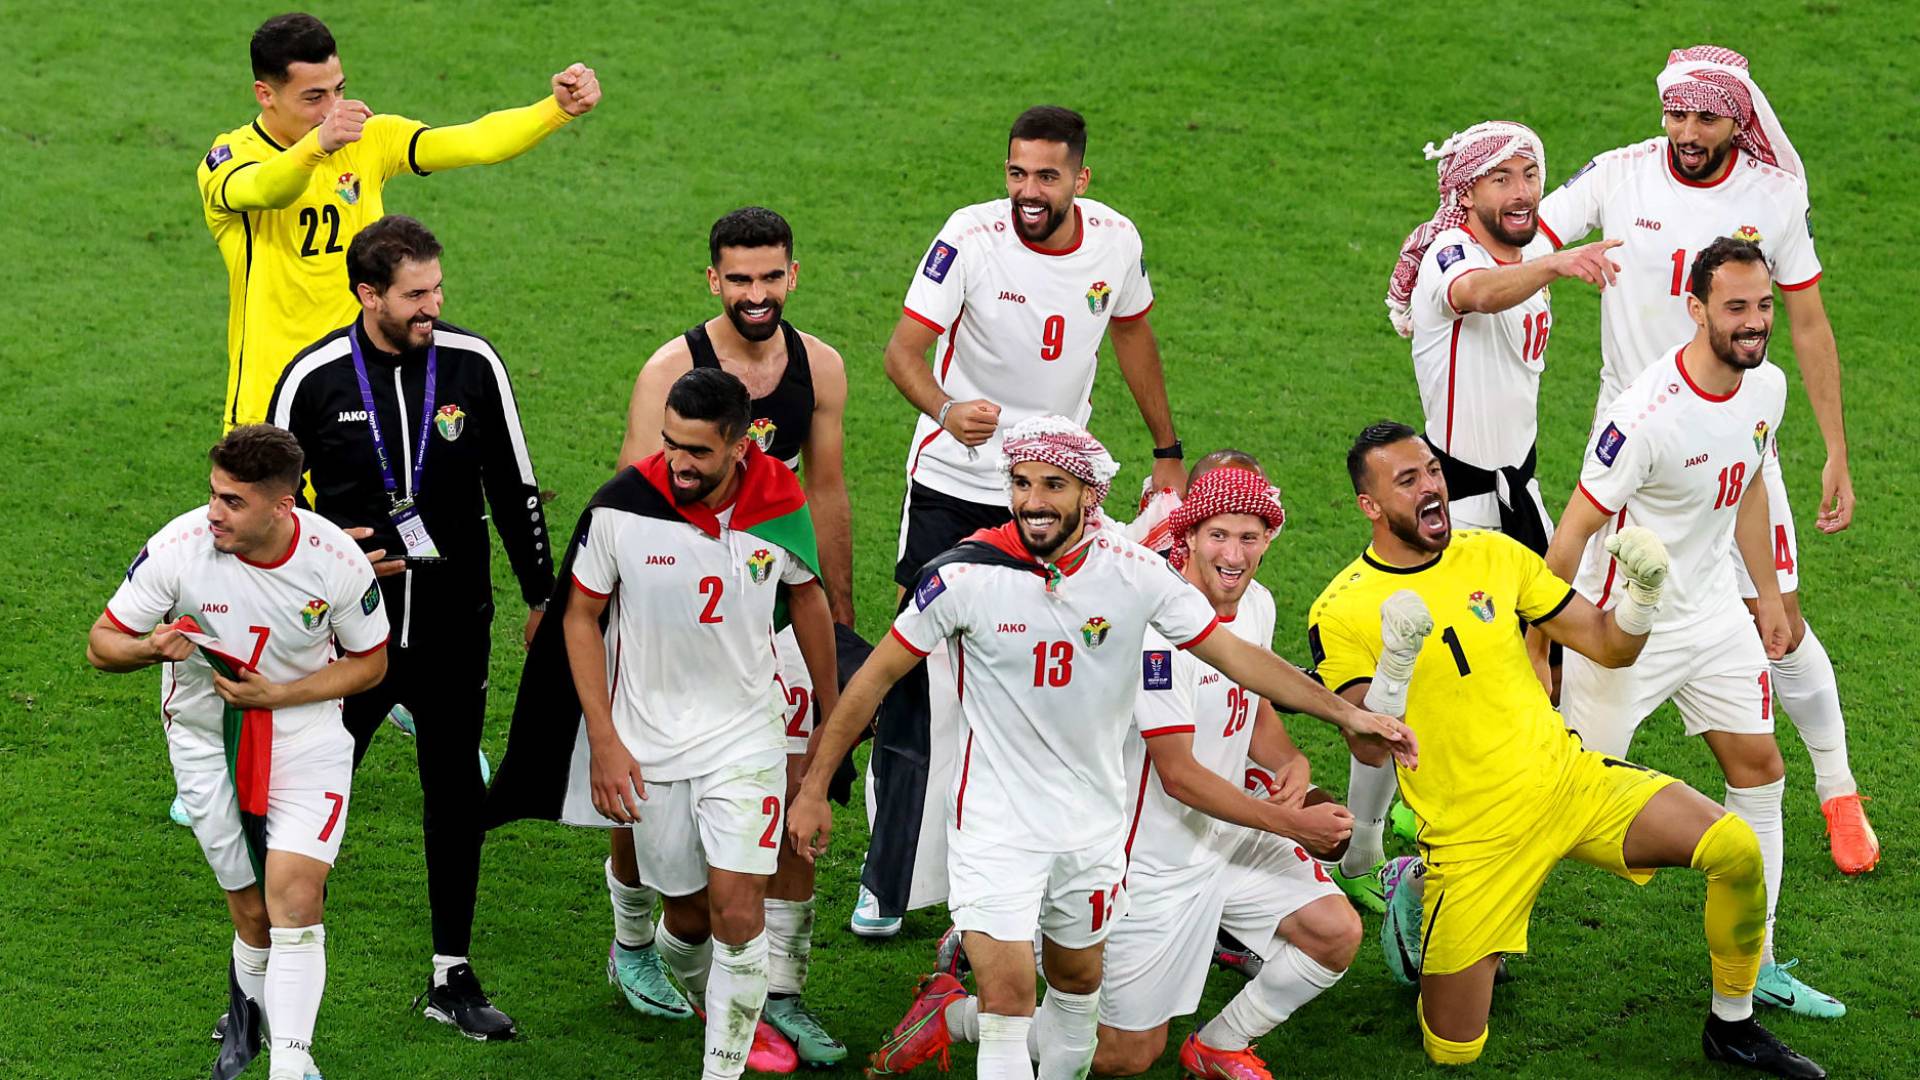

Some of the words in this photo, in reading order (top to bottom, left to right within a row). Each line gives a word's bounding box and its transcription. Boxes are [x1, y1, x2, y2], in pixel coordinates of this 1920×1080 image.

[299, 204, 343, 257] 22
[1634, 217, 1661, 231] JAKO
[1670, 248, 1700, 296] 1
[997, 290, 1026, 304] JAKO
[1040, 315, 1065, 361] 9
[1522, 311, 1549, 363] 16
[337, 410, 368, 422] JAKO
[1684, 453, 1709, 469] JAKO
[1713, 461, 1746, 511] 18
[645, 555, 676, 566] JAKO
[201, 603, 229, 614] JAKO
[699, 576, 724, 624] 2
[249, 625, 271, 670] 7
[997, 623, 1027, 633] JAKO
[1441, 626, 1472, 677] 1
[1032, 640, 1074, 688] 13
[1199, 673, 1219, 686] JAKO
[786, 686, 816, 738] 2
[1223, 687, 1249, 738] 25
[317, 791, 344, 843] 7
[758, 795, 781, 849] 2
[709, 1047, 742, 1062] JAKO
